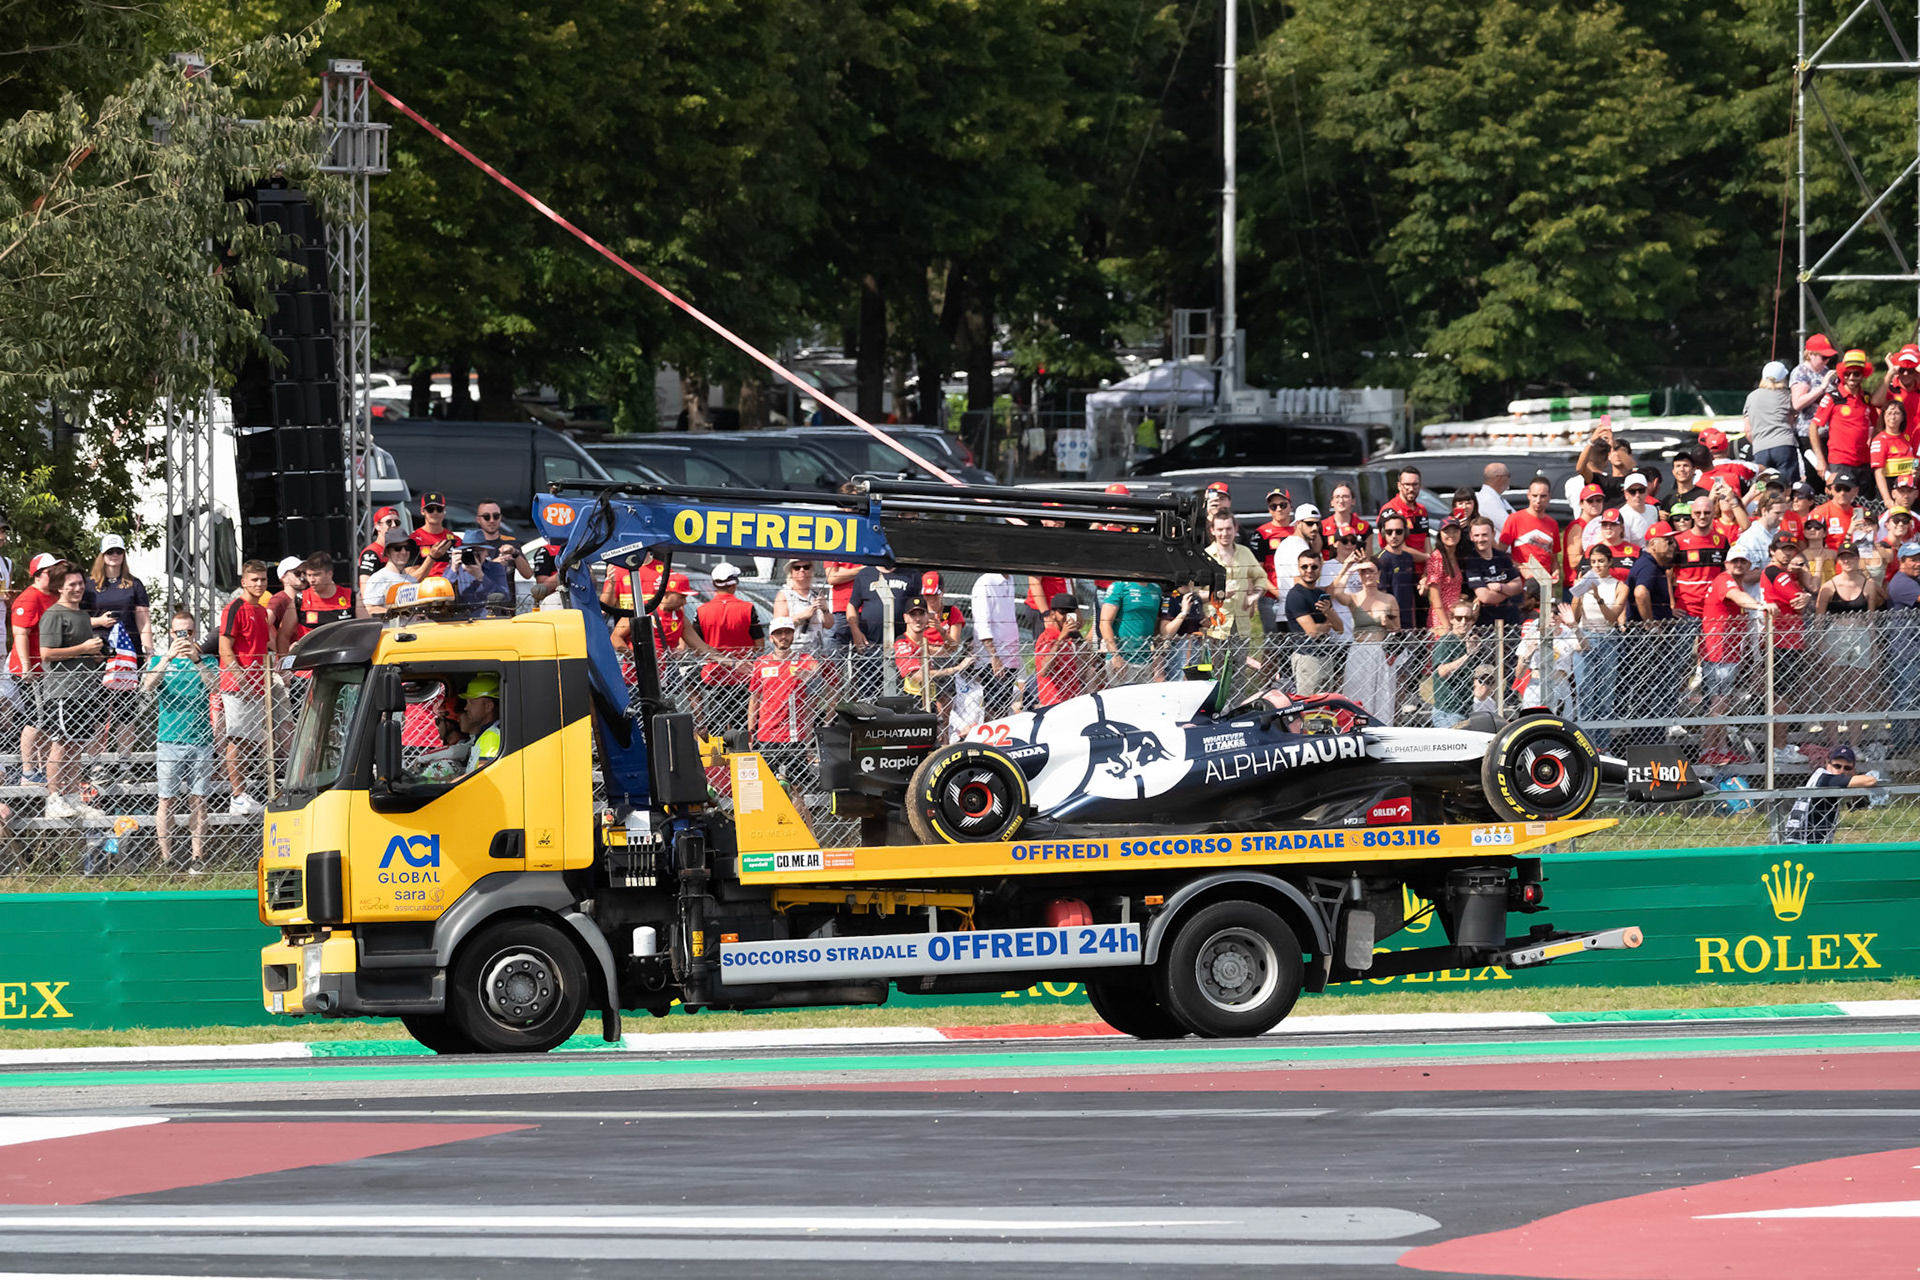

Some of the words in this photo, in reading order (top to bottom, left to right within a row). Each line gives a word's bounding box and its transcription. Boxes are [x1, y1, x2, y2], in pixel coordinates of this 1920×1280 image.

[546, 506, 572, 525] PM
[673, 509, 858, 552] OFFREDI
[865, 728, 933, 739] ALPHATAURI
[977, 724, 1013, 747] 22
[1203, 732, 1244, 744] WHATEVER
[880, 755, 919, 770] Rapid
[1006, 746, 1047, 760] NDA
[1205, 736, 1366, 784] ALPHATAURI
[929, 751, 963, 788] ZERO
[1628, 759, 1689, 792] FLEXBOX
[1497, 773, 1526, 814] ZERO
[1372, 807, 1397, 818] ORLEN
[378, 834, 440, 868] ACI
[1011, 843, 1109, 861] OFFREDI
[1120, 837, 1232, 857] SOCCORSO
[1241, 833, 1345, 852] STRADALE
[1363, 830, 1440, 847] 803.116
[378, 871, 440, 884] GLOBAL
[394, 890, 426, 901] sara
[394, 904, 445, 912] assicurazioni
[722, 948, 822, 966] SOCCORSO
[826, 944, 918, 962] STRADALE
[928, 931, 1069, 961] OFFREDI
[1078, 928, 1139, 954] 24h
[1695, 933, 1882, 974] ROLEX
